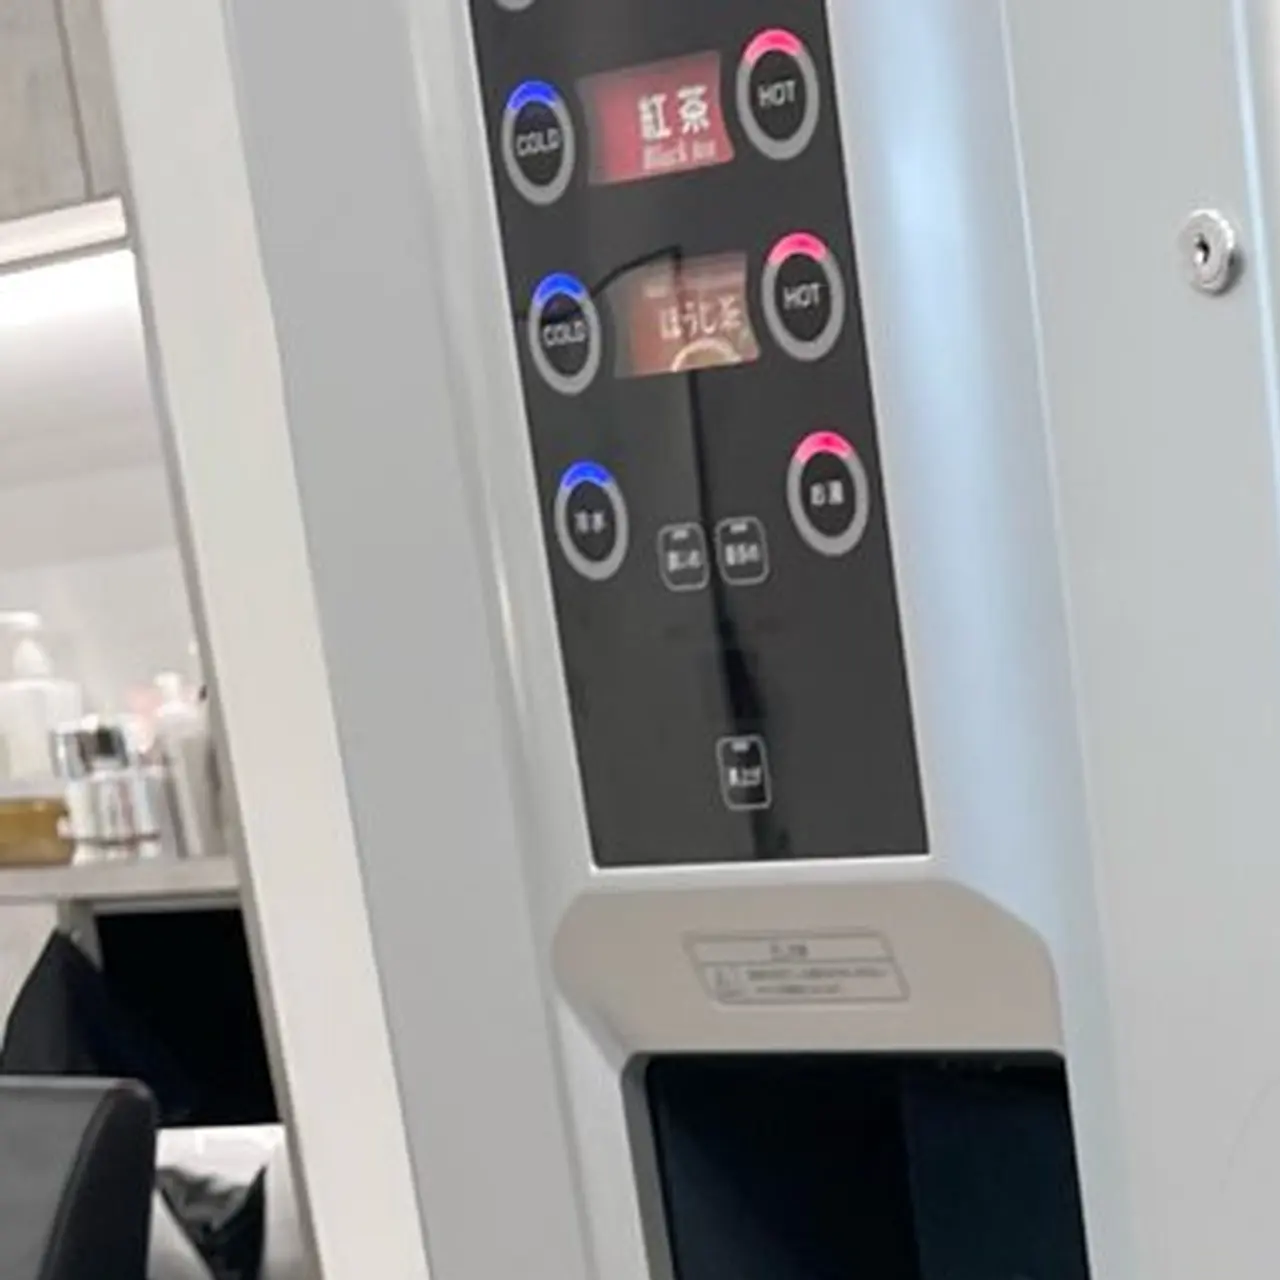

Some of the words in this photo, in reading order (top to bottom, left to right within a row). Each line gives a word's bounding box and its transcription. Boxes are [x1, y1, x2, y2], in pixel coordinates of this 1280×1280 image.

[758, 80, 796, 108] HOT
[639, 85, 709, 140] 紅茶
[516, 129, 561, 157] COLD
[783, 283, 820, 310] HOT
[543, 321, 587, 347] COLD
